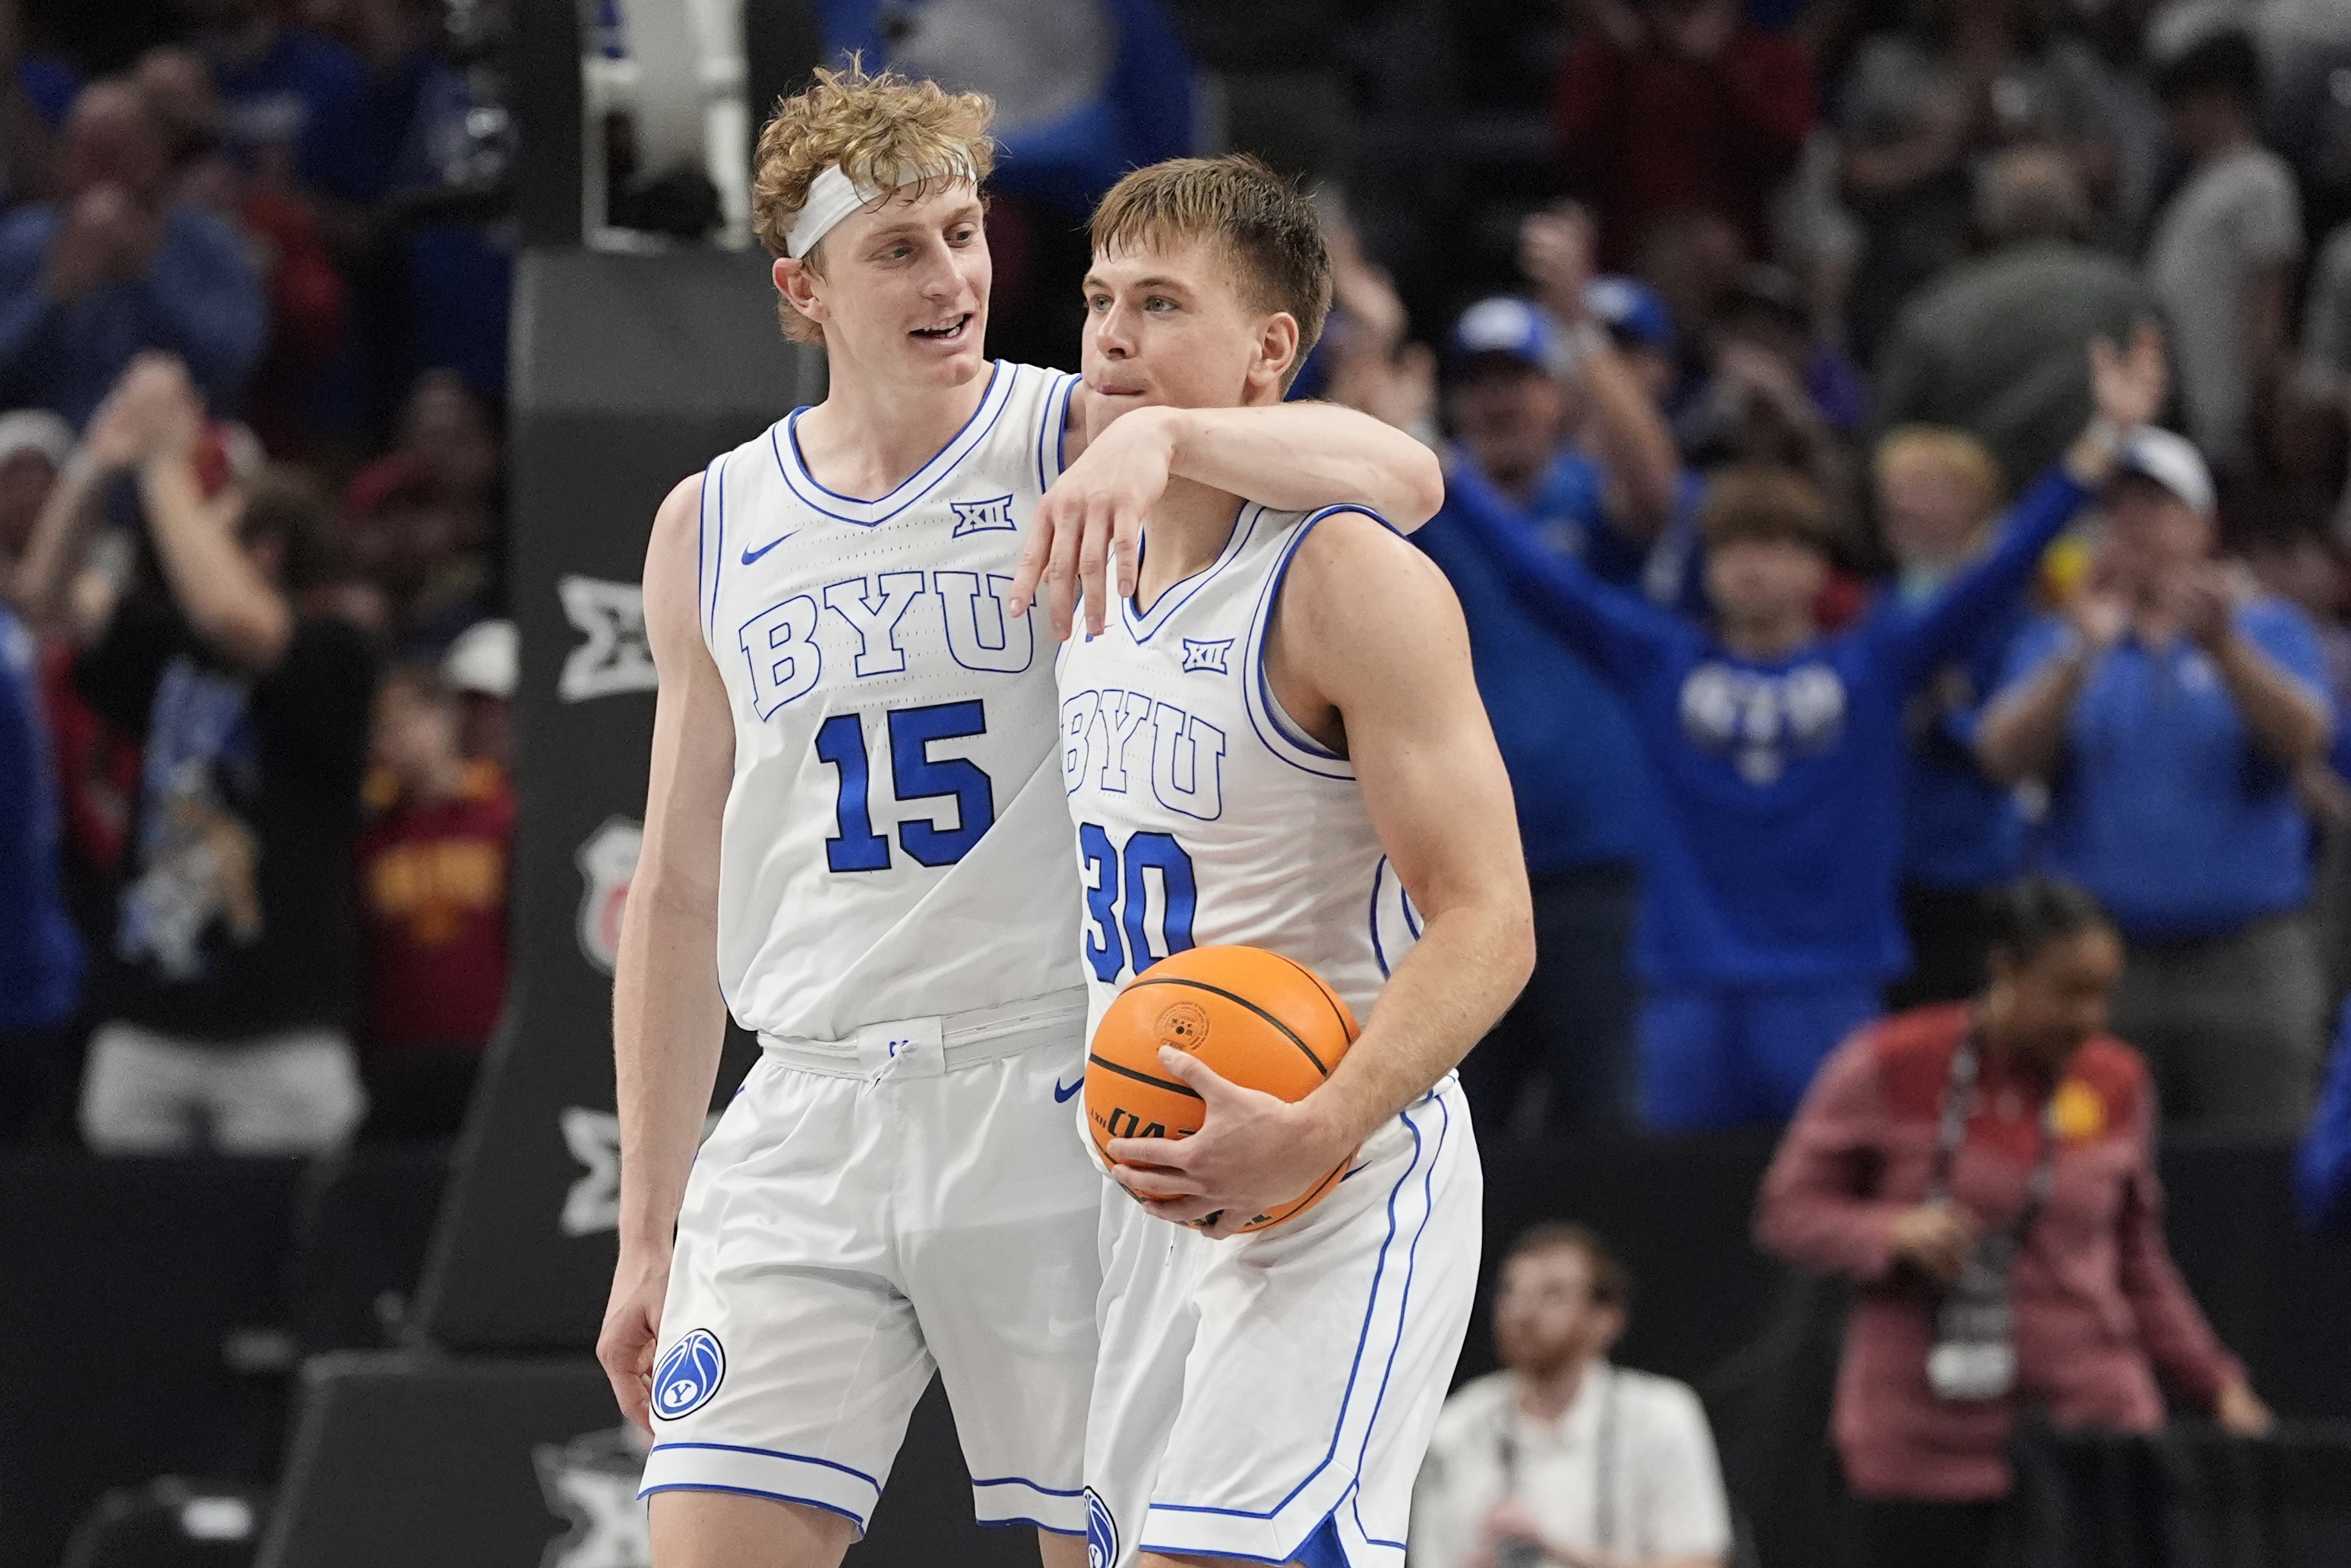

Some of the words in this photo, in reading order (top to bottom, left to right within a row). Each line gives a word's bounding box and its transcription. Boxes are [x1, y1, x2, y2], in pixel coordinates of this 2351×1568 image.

[739, 571, 1036, 722] BYU
[814, 698, 994, 873] 15
[1060, 688, 1226, 821] BYU
[1079, 822, 1197, 985] 30
[671, 1383, 692, 1404] Y
